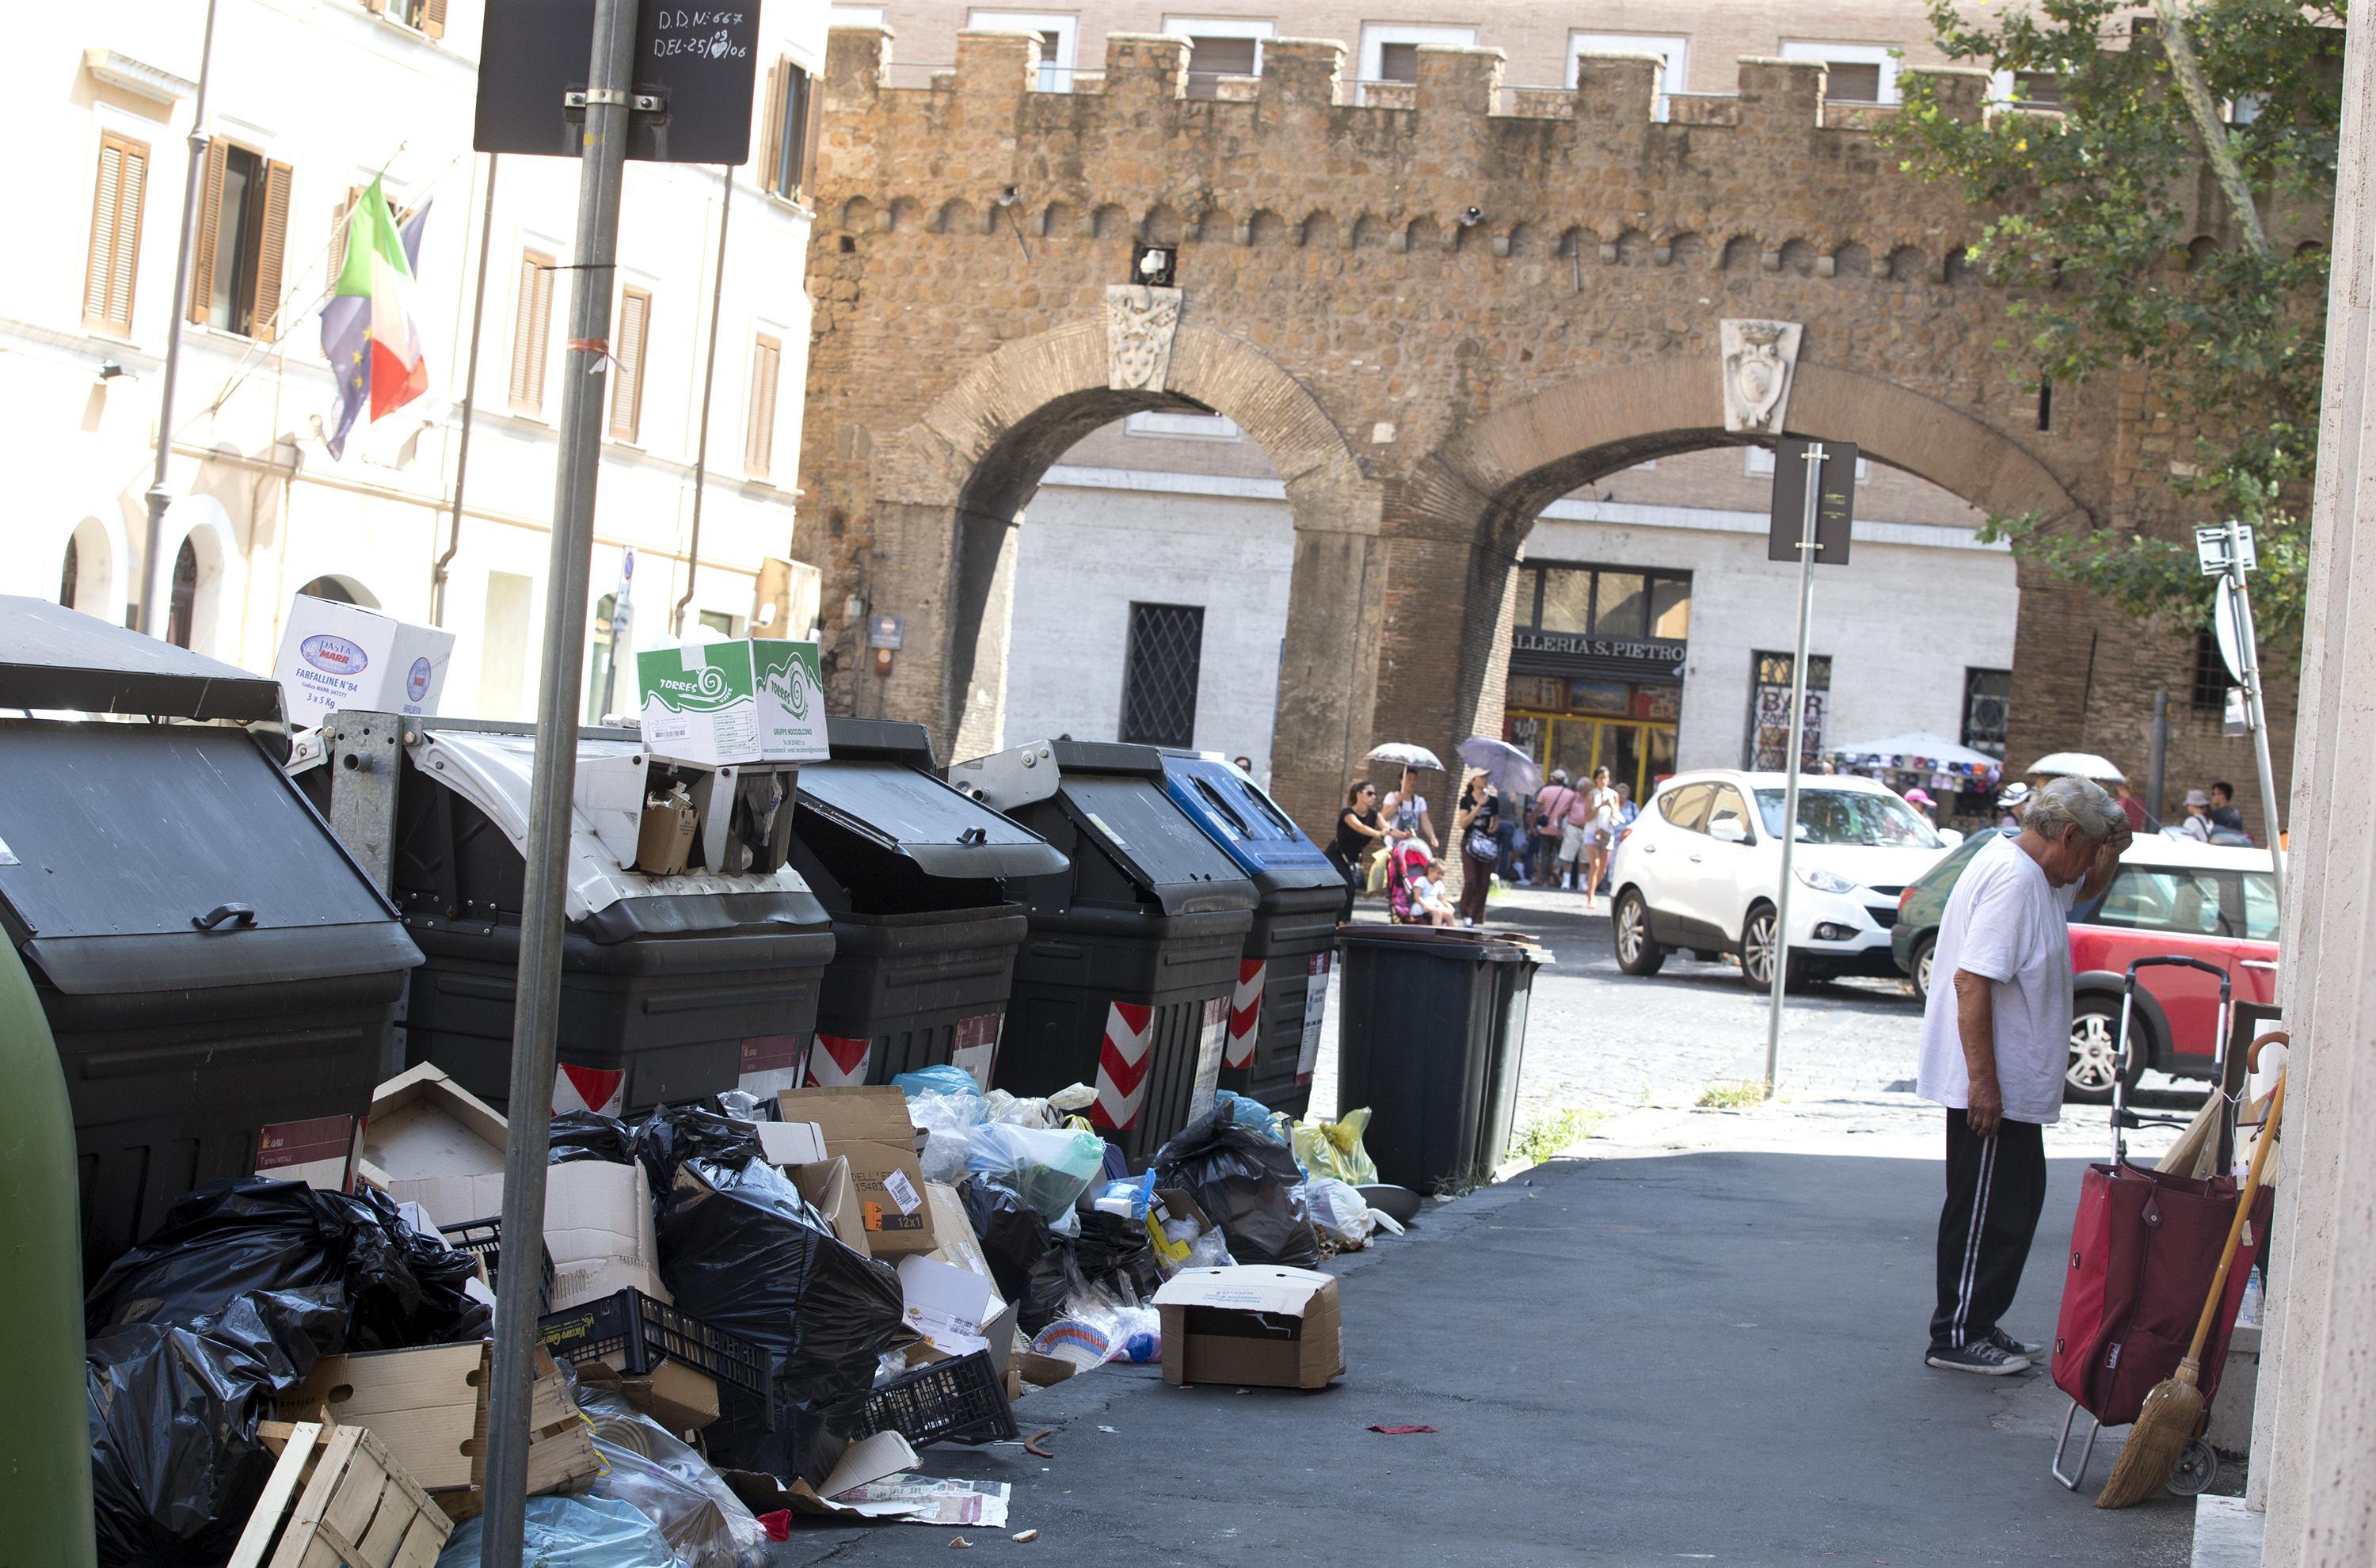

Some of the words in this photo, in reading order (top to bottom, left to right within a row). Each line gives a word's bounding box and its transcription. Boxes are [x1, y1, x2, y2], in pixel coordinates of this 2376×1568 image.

[319, 640, 351, 655] PASTA
[1512, 634, 1590, 655] LLERIA
[1611, 642, 1685, 662] PIETRO
[319, 649, 350, 664] MARR
[295, 668, 340, 687] FARFALLINE
[660, 679, 698, 693] TORRES
[771, 679, 790, 705] TORRES
[326, 698, 336, 710] Kg
[851, 1171, 912, 1182] DELL'EO
[898, 1216, 920, 1227] 12x1
